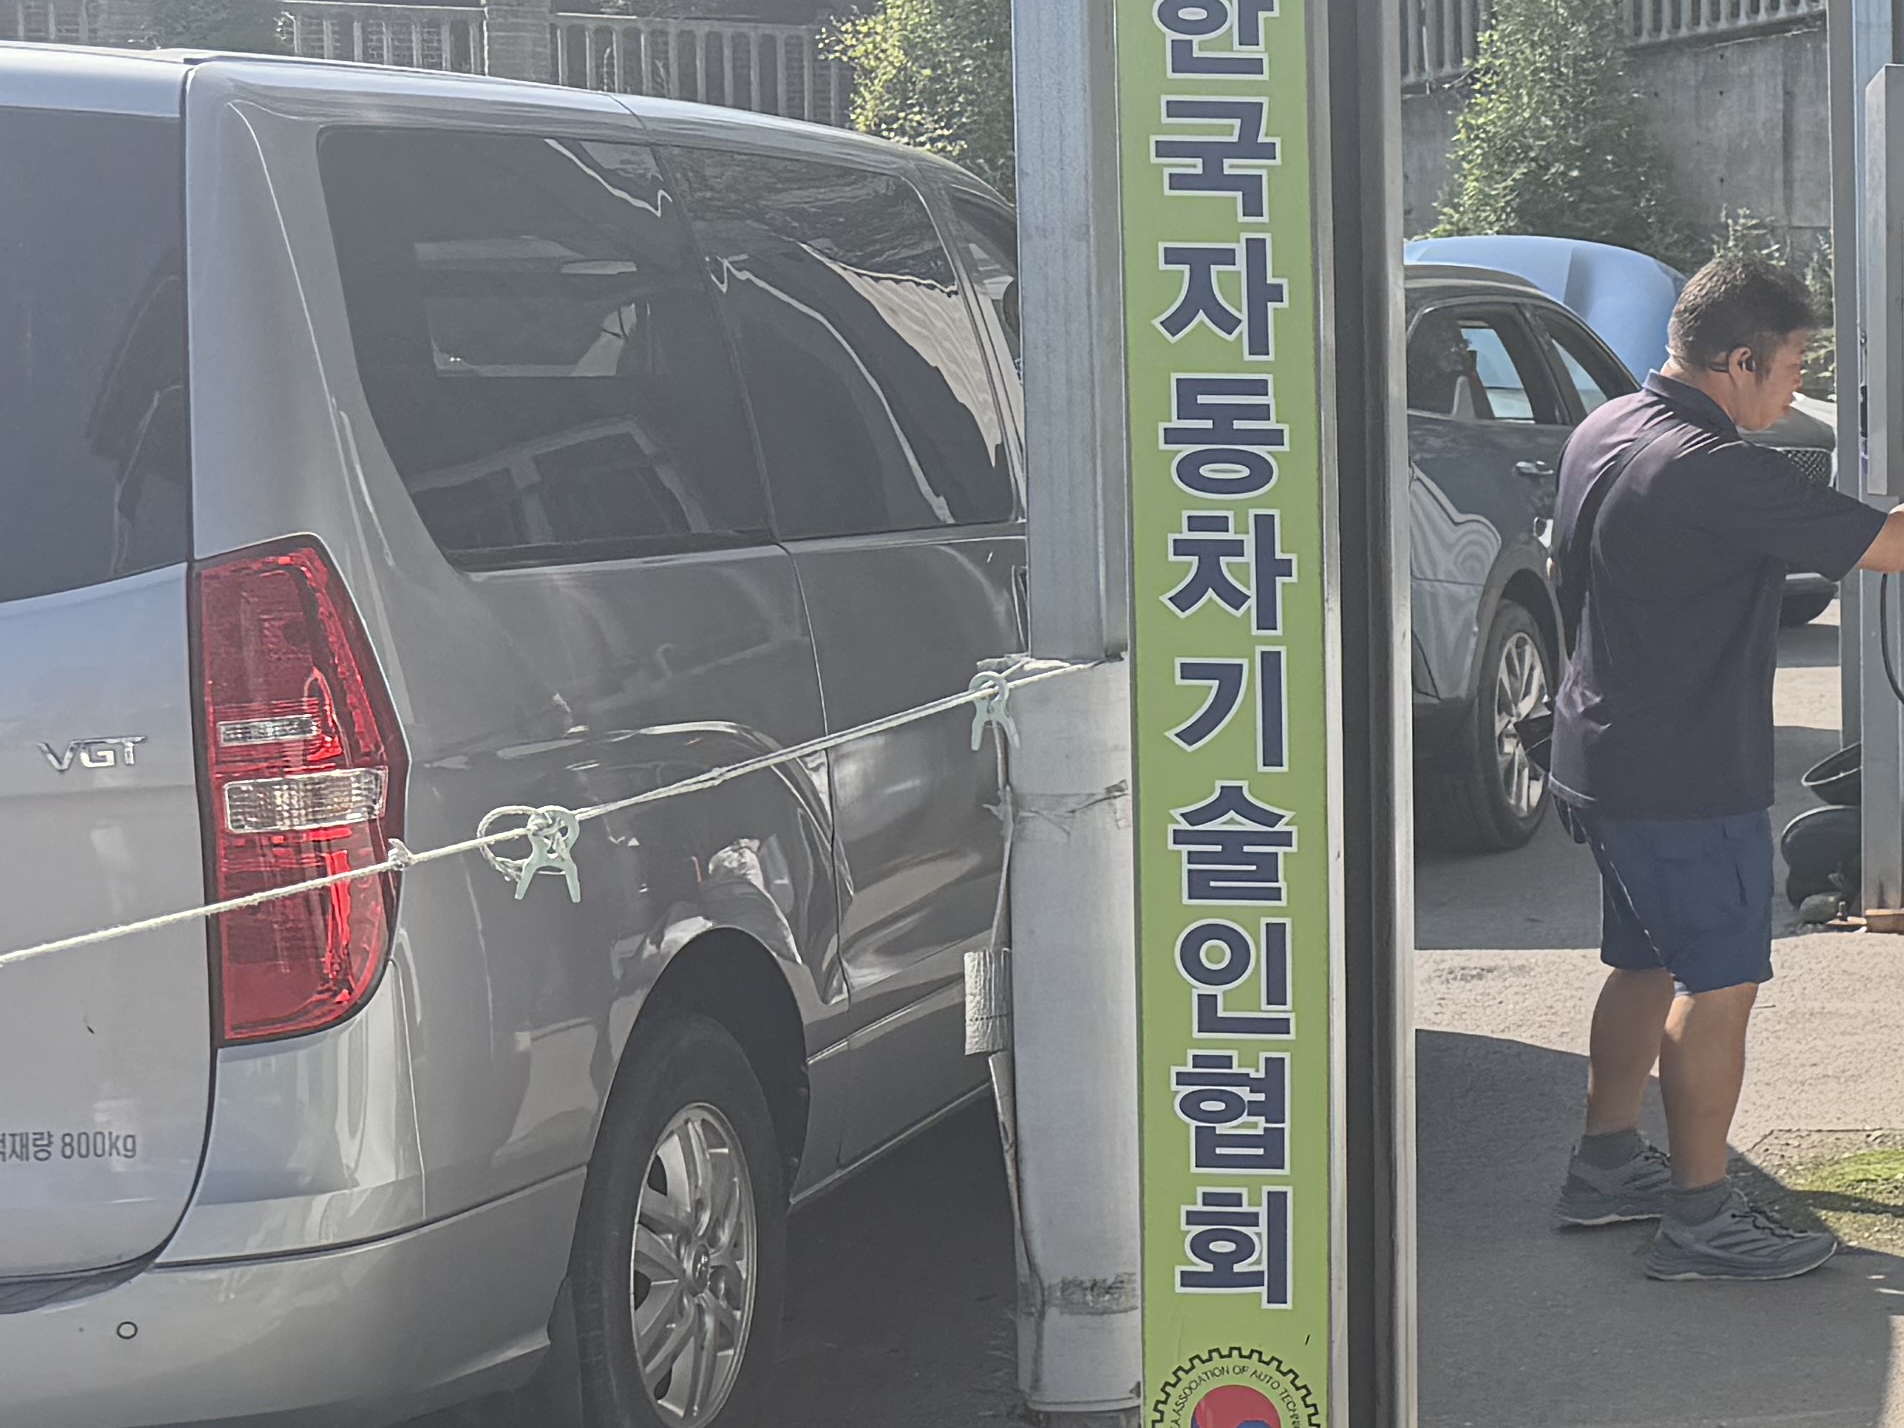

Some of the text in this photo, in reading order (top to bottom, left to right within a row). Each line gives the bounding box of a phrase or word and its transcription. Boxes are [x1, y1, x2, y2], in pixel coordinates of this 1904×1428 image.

[37, 736, 147, 772] VGT
[61, 1131, 137, 1159] 800kg
[1172, 1365, 1230, 1416] ASSOCIATION
[1232, 1365, 1249, 1375] OF
[1250, 1369, 1280, 1390] AUTO
